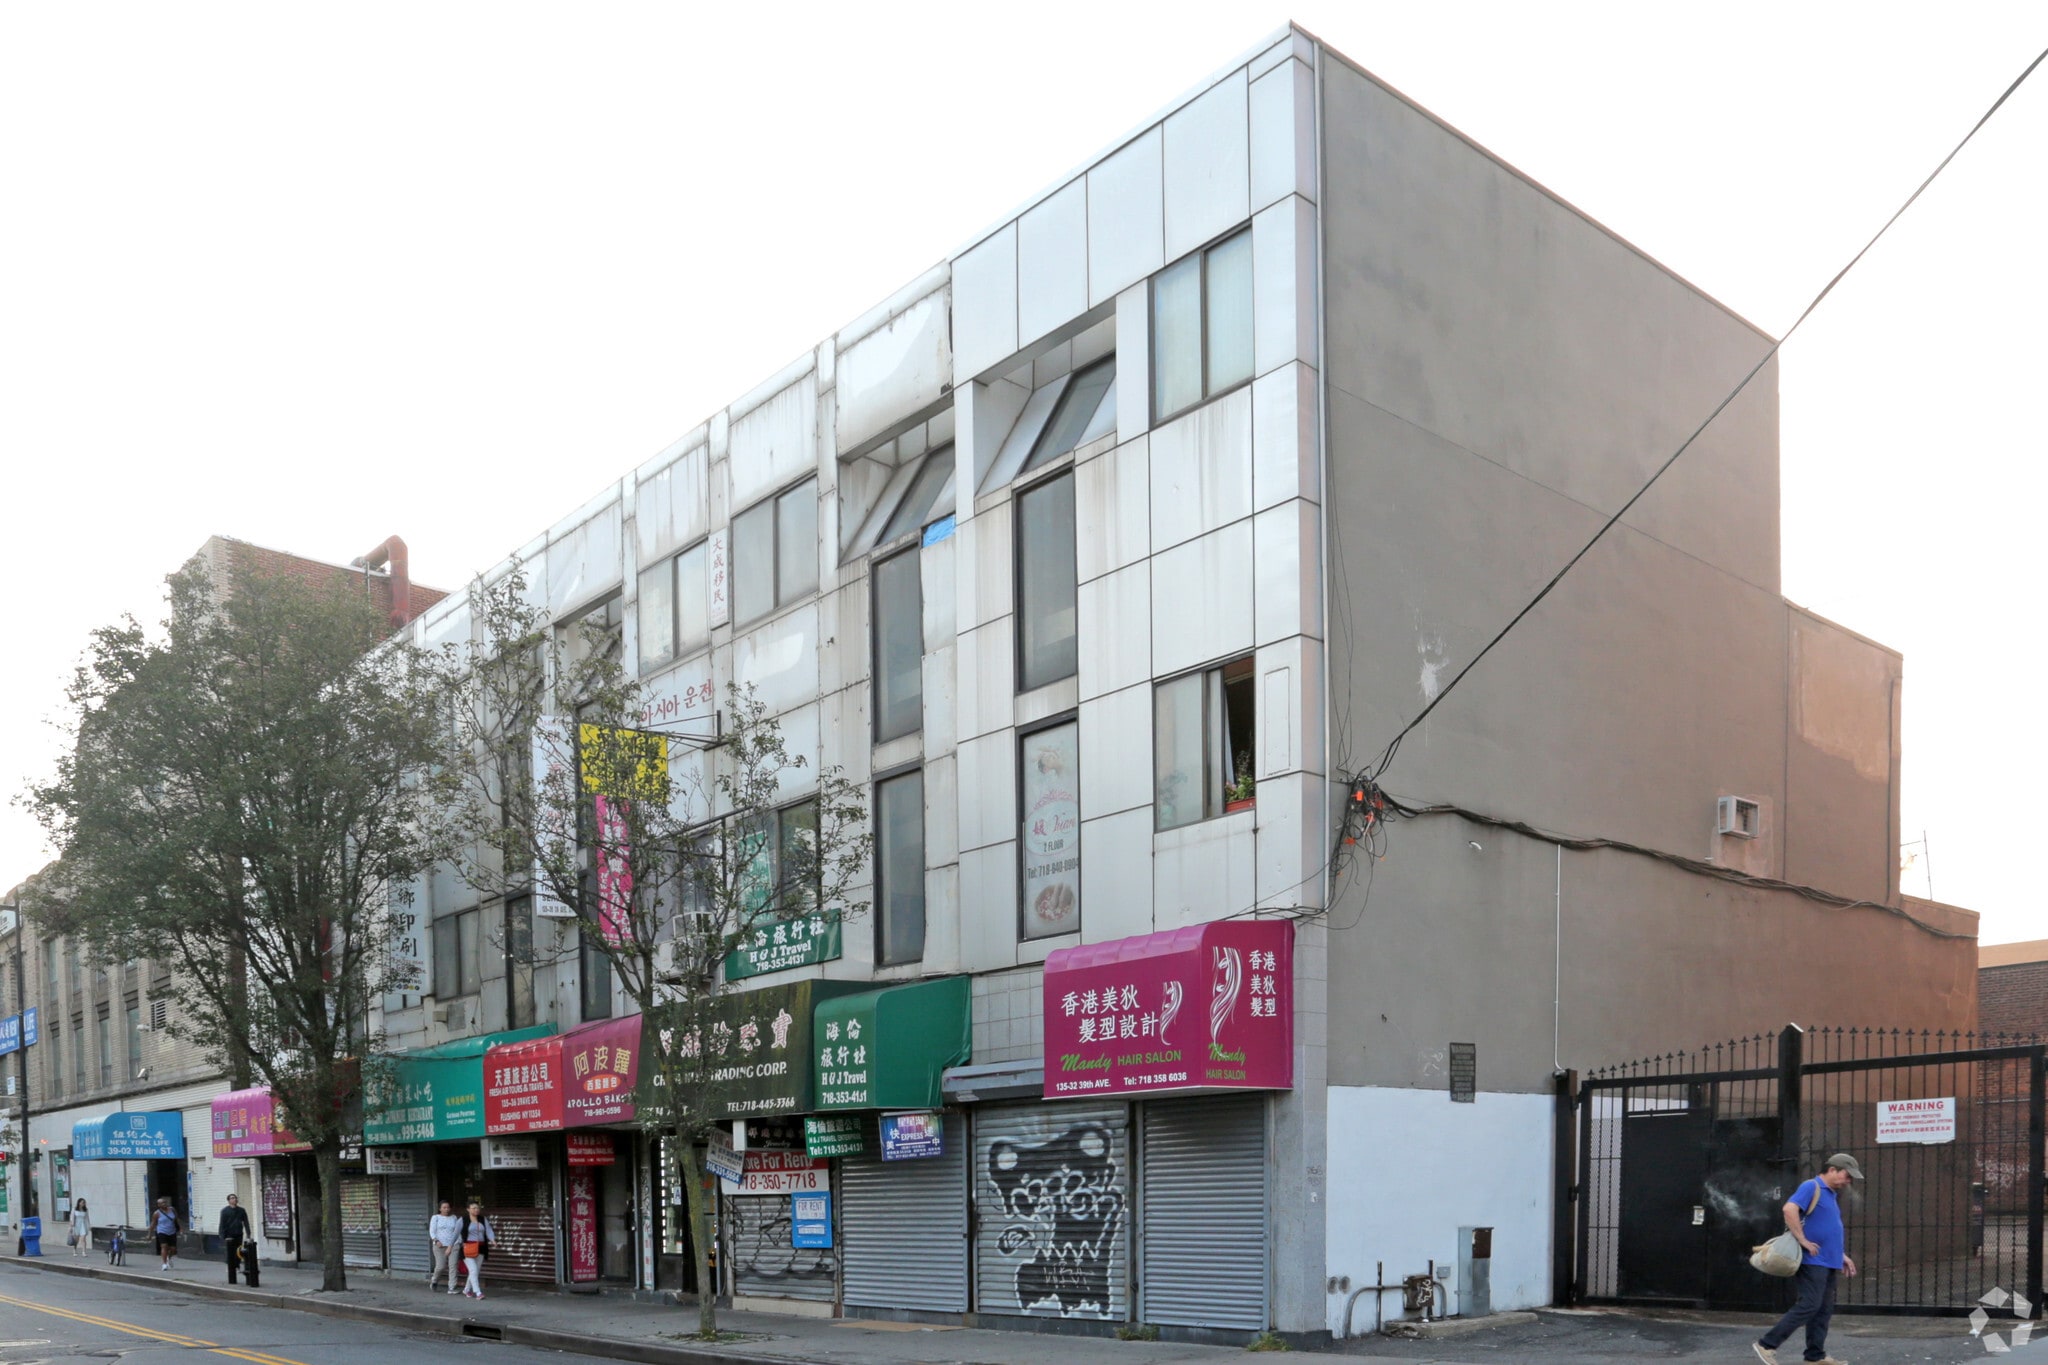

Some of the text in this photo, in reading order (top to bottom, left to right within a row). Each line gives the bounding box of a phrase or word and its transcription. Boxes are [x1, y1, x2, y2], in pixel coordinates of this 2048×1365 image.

[750, 951, 758, 963] H
[771, 946, 777, 957] J
[780, 940, 811, 957] Travel
[756, 954, 804, 972] 718-353-4131
[1249, 950, 1276, 972] 香港
[1249, 973, 1277, 996] 美狄
[1060, 985, 1140, 1017] 香港美狄
[1250, 997, 1277, 1018] 髮型
[1078, 1011, 1159, 1044] 髮型設計
[821, 1045, 866, 1067] 旅行社
[1060, 1050, 1182, 1073] Mandy HAIR SALON
[1207, 1042, 1246, 1066] Mandy
[756, 1061, 787, 1076] CORP.
[822, 1072, 828, 1085] H
[837, 1072, 842, 1085] J
[843, 1070, 866, 1084] Travel
[1206, 1069, 1246, 1081] HAIR SALON
[1056, 1078, 1112, 1092] 135-32 39th AVE.
[1123, 1071, 1187, 1087] Tel: 718 358 6036
[567, 1092, 634, 1109] APOLLO BAK
[1888, 1101, 1944, 1112] WARNING
[107, 1146, 132, 1155] 39-02
[135, 1146, 157, 1155] Main
[761, 1152, 780, 1170] For
